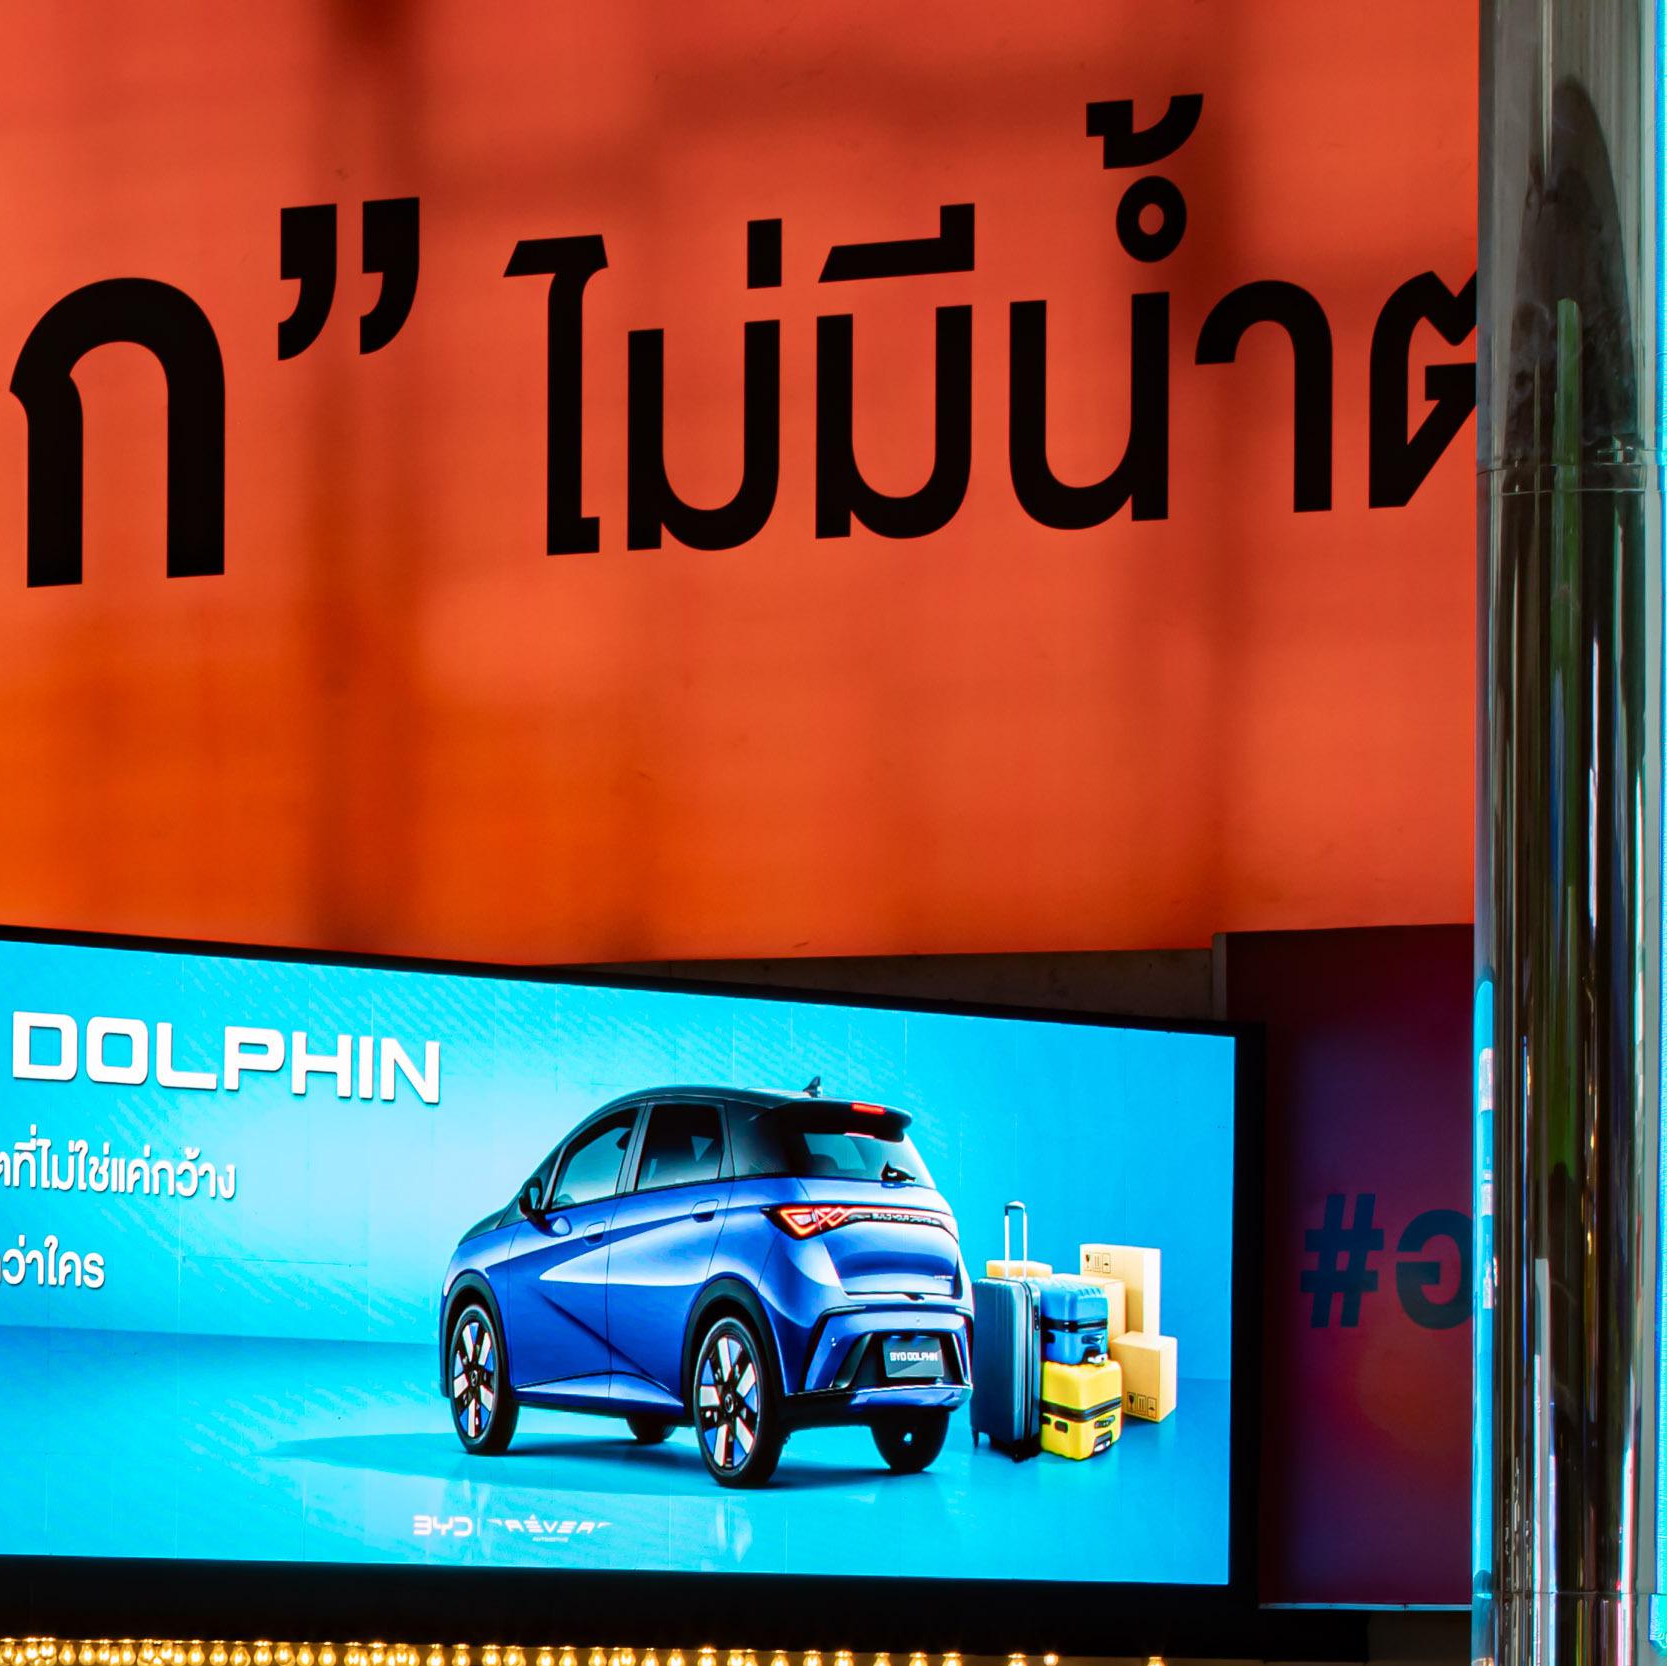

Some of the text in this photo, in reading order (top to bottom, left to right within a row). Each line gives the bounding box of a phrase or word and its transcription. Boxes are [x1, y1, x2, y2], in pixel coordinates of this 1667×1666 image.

[12, 1010, 443, 1105] DOLPHIN
[889, 1351, 939, 1362] BYD DOLPHIN
[413, 1515, 473, 1537] BYD
